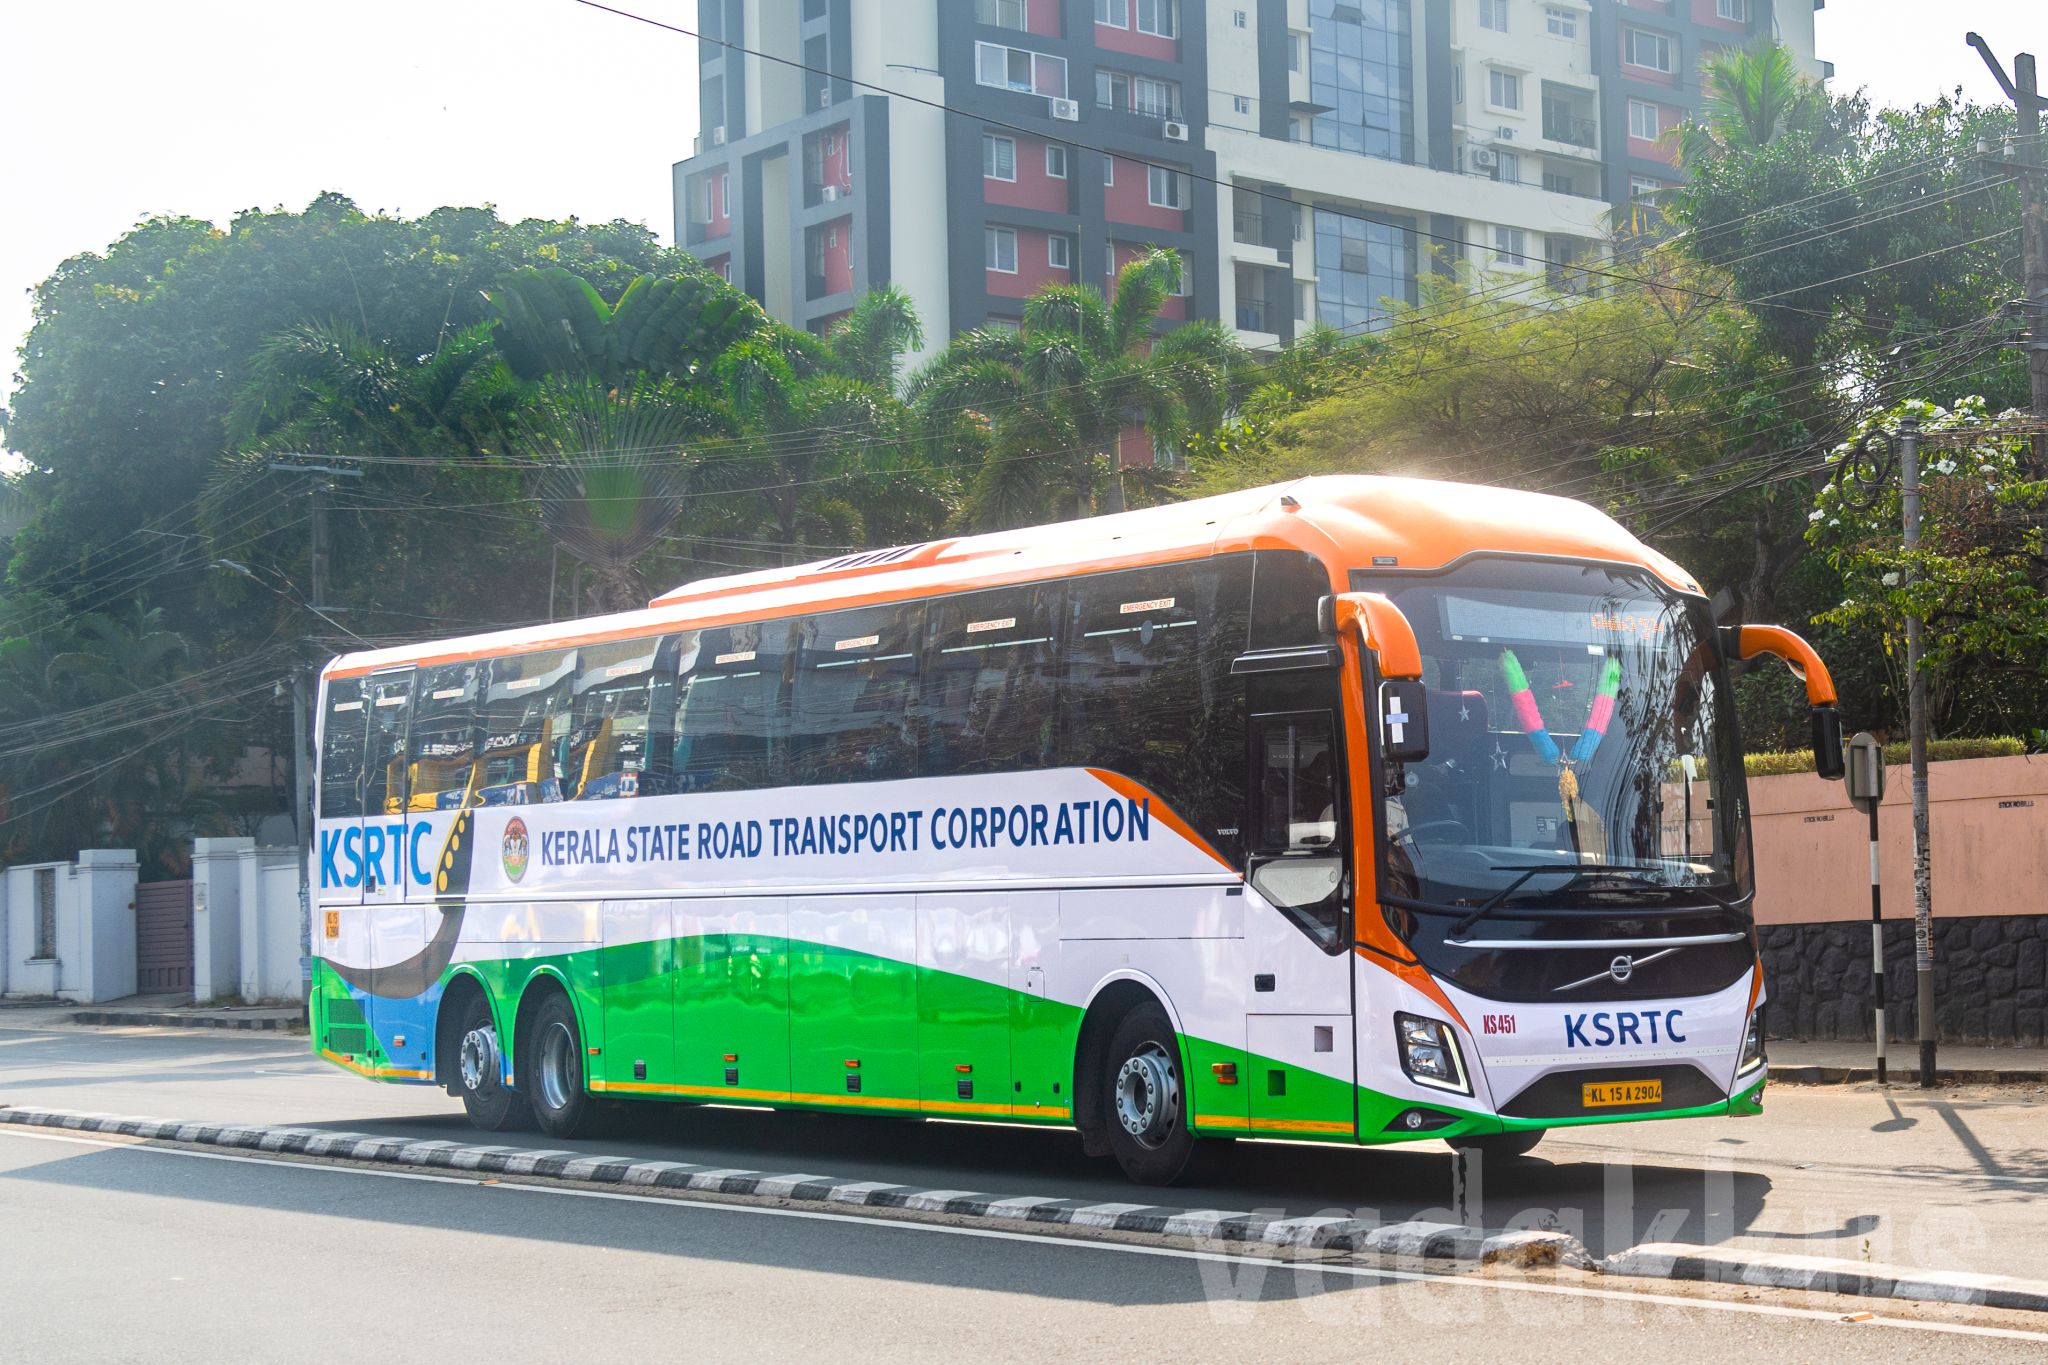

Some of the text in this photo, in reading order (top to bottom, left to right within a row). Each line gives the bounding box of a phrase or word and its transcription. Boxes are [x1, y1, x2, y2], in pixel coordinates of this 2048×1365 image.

[1121, 599, 1172, 613] EMERGENCY EXIT
[968, 619, 1013, 632] EMERGENCY EXIT
[542, 797, 1149, 866] KERALA STATE ROAD TRANSPORT CORPORATION
[1217, 828, 1239, 836] VOLVO
[321, 821, 432, 888] KSRTC
[1563, 1009, 1686, 1048] KSRTC
[1591, 1085, 1661, 1102] KL 15 A 2904
